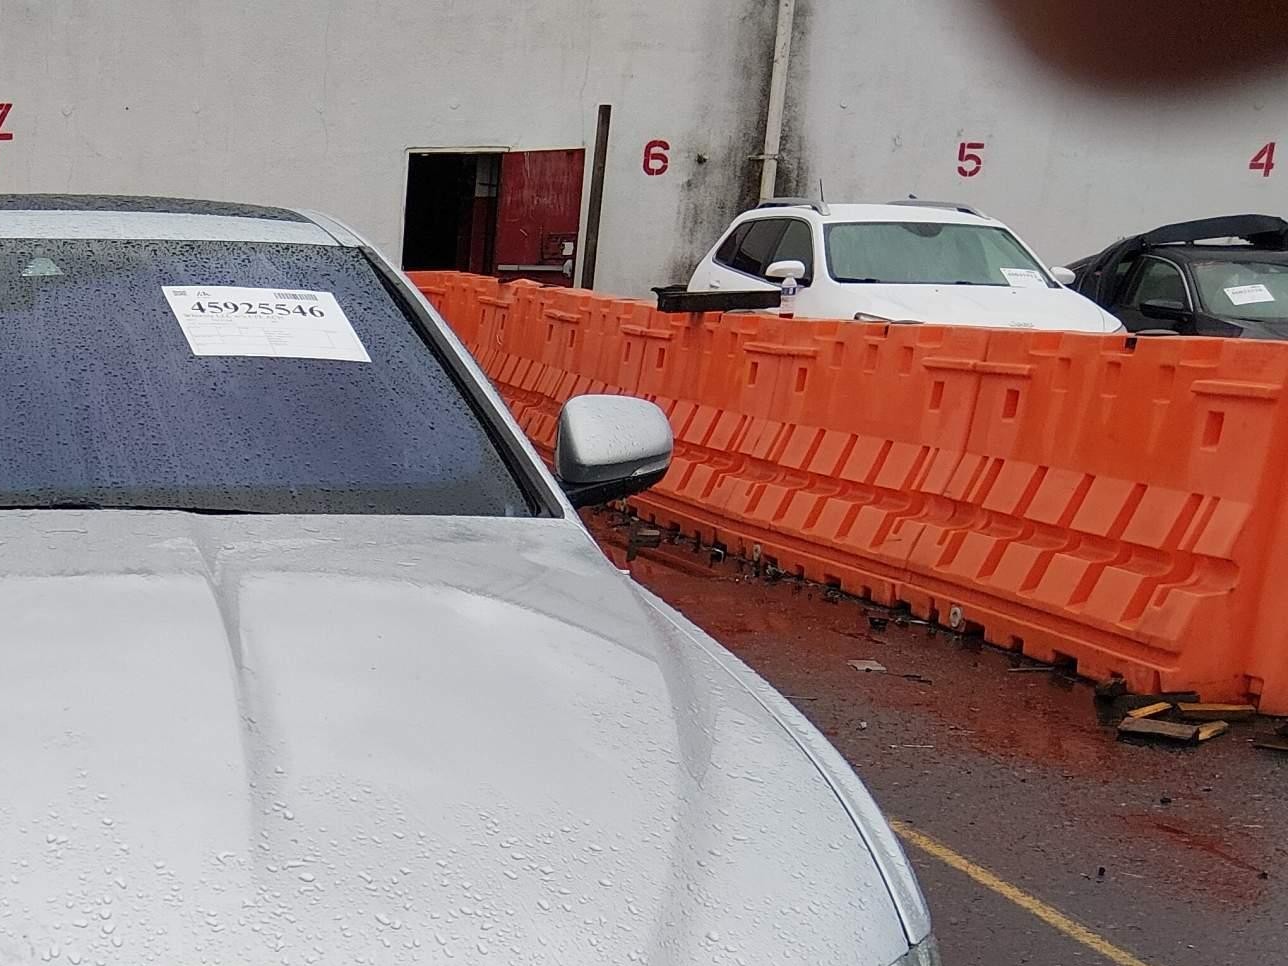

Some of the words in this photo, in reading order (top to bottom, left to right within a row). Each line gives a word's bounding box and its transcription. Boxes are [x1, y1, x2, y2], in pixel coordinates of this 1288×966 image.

[643, 139, 671, 176] 6
[957, 142, 985, 177] 5
[1249, 142, 1276, 177] 4
[191, 300, 326, 319] 45925546
